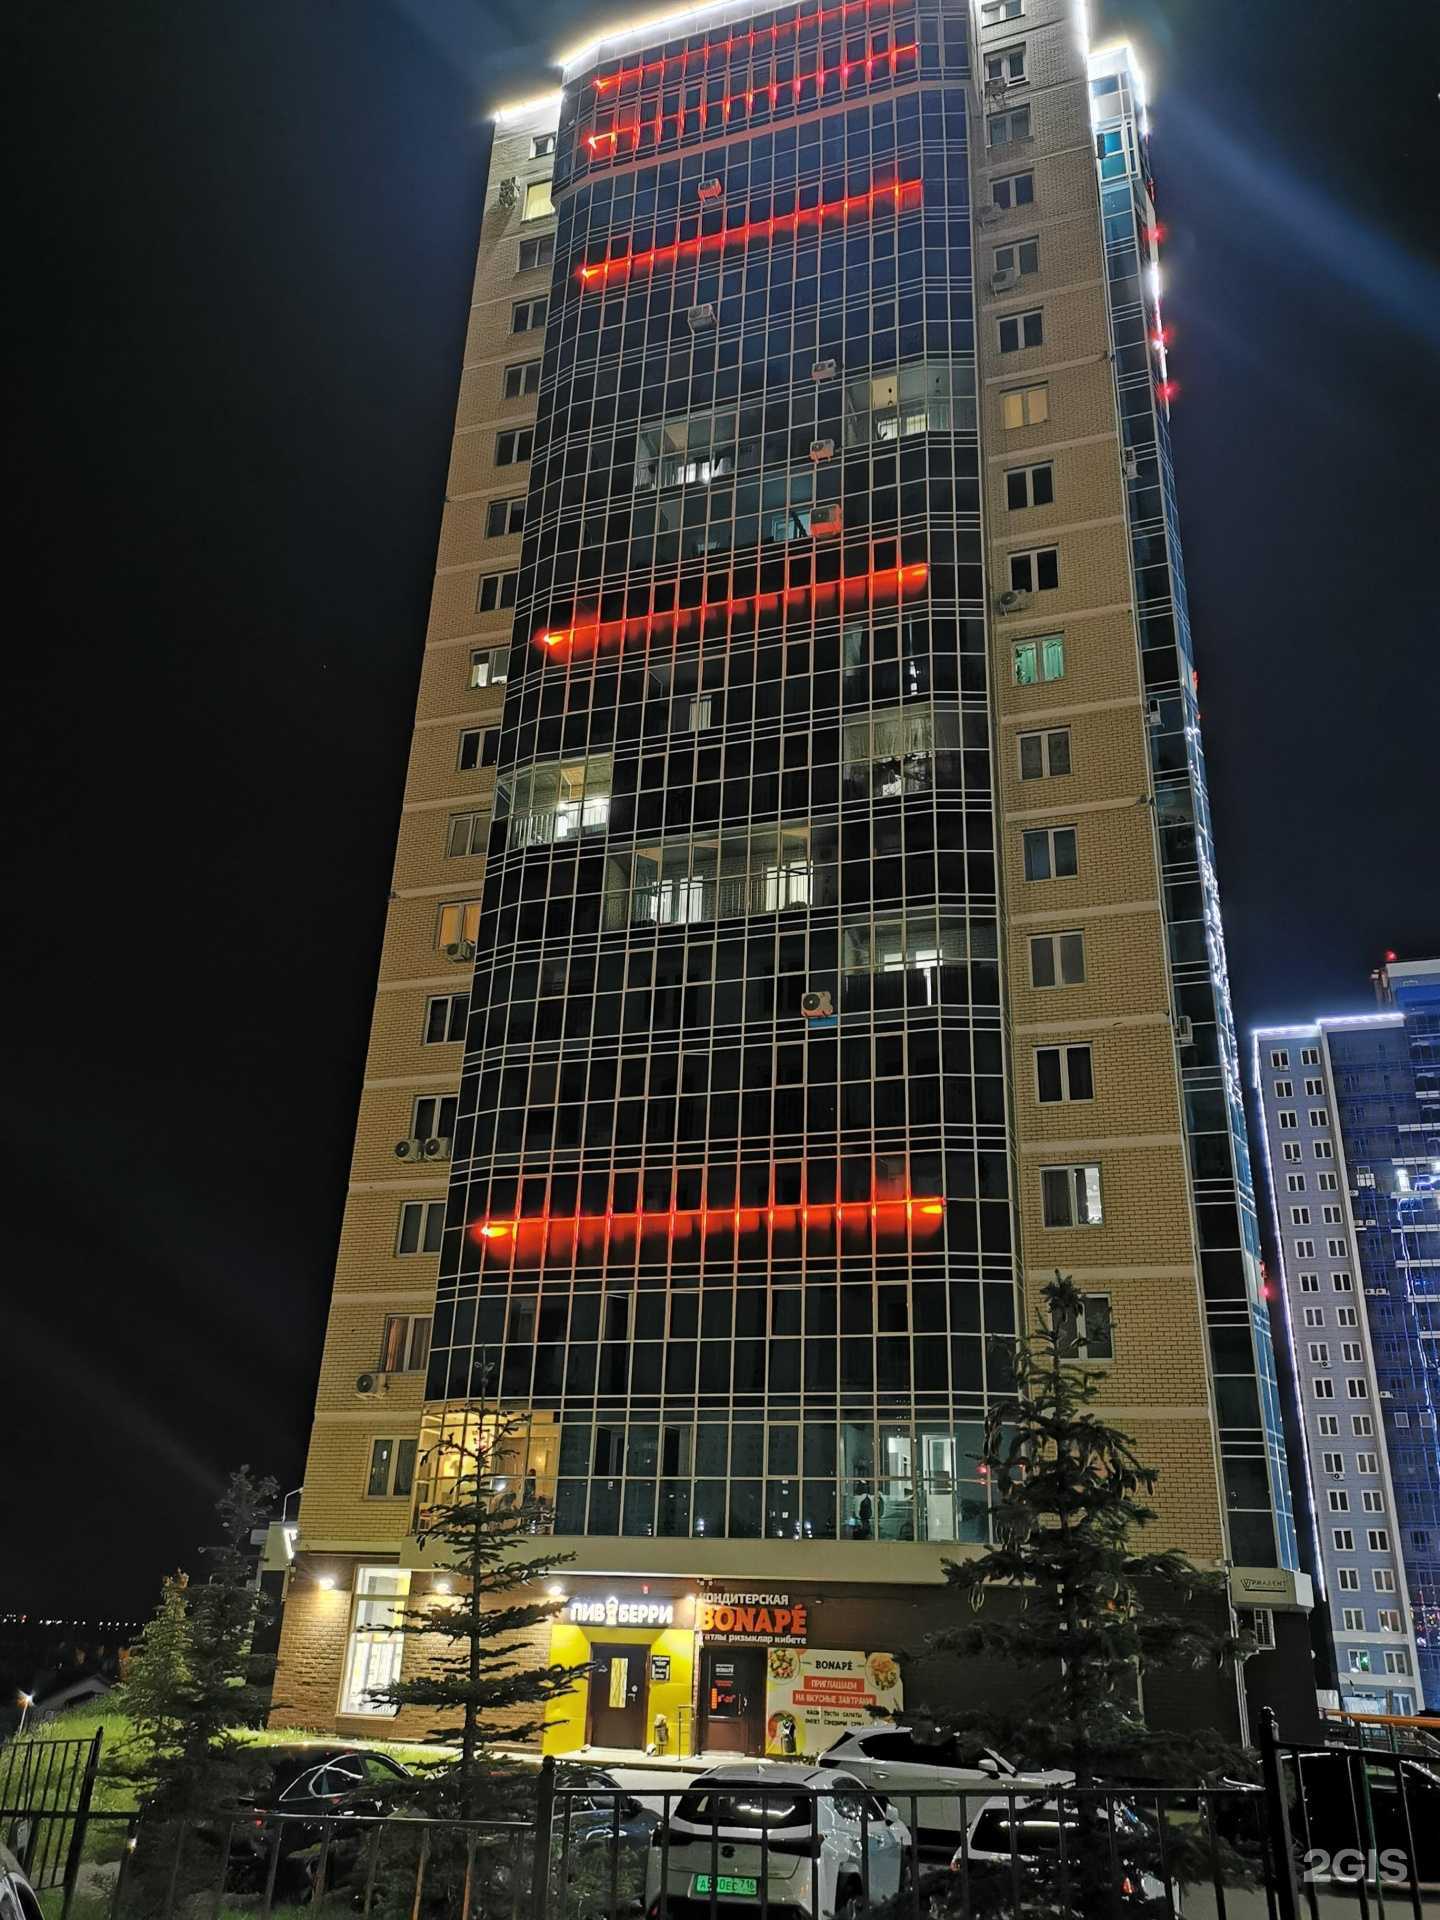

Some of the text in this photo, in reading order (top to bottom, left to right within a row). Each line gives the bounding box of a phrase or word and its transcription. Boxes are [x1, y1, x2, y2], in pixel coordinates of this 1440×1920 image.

[700, 1603, 808, 1634] BONAPÉ
[702, 1633, 727, 1642] атлы
[816, 1660, 854, 1670] BONAPÉ
[811, 1679, 857, 1690] ПРИГЛАШАЕМ
[795, 1693, 805, 1701] НА
